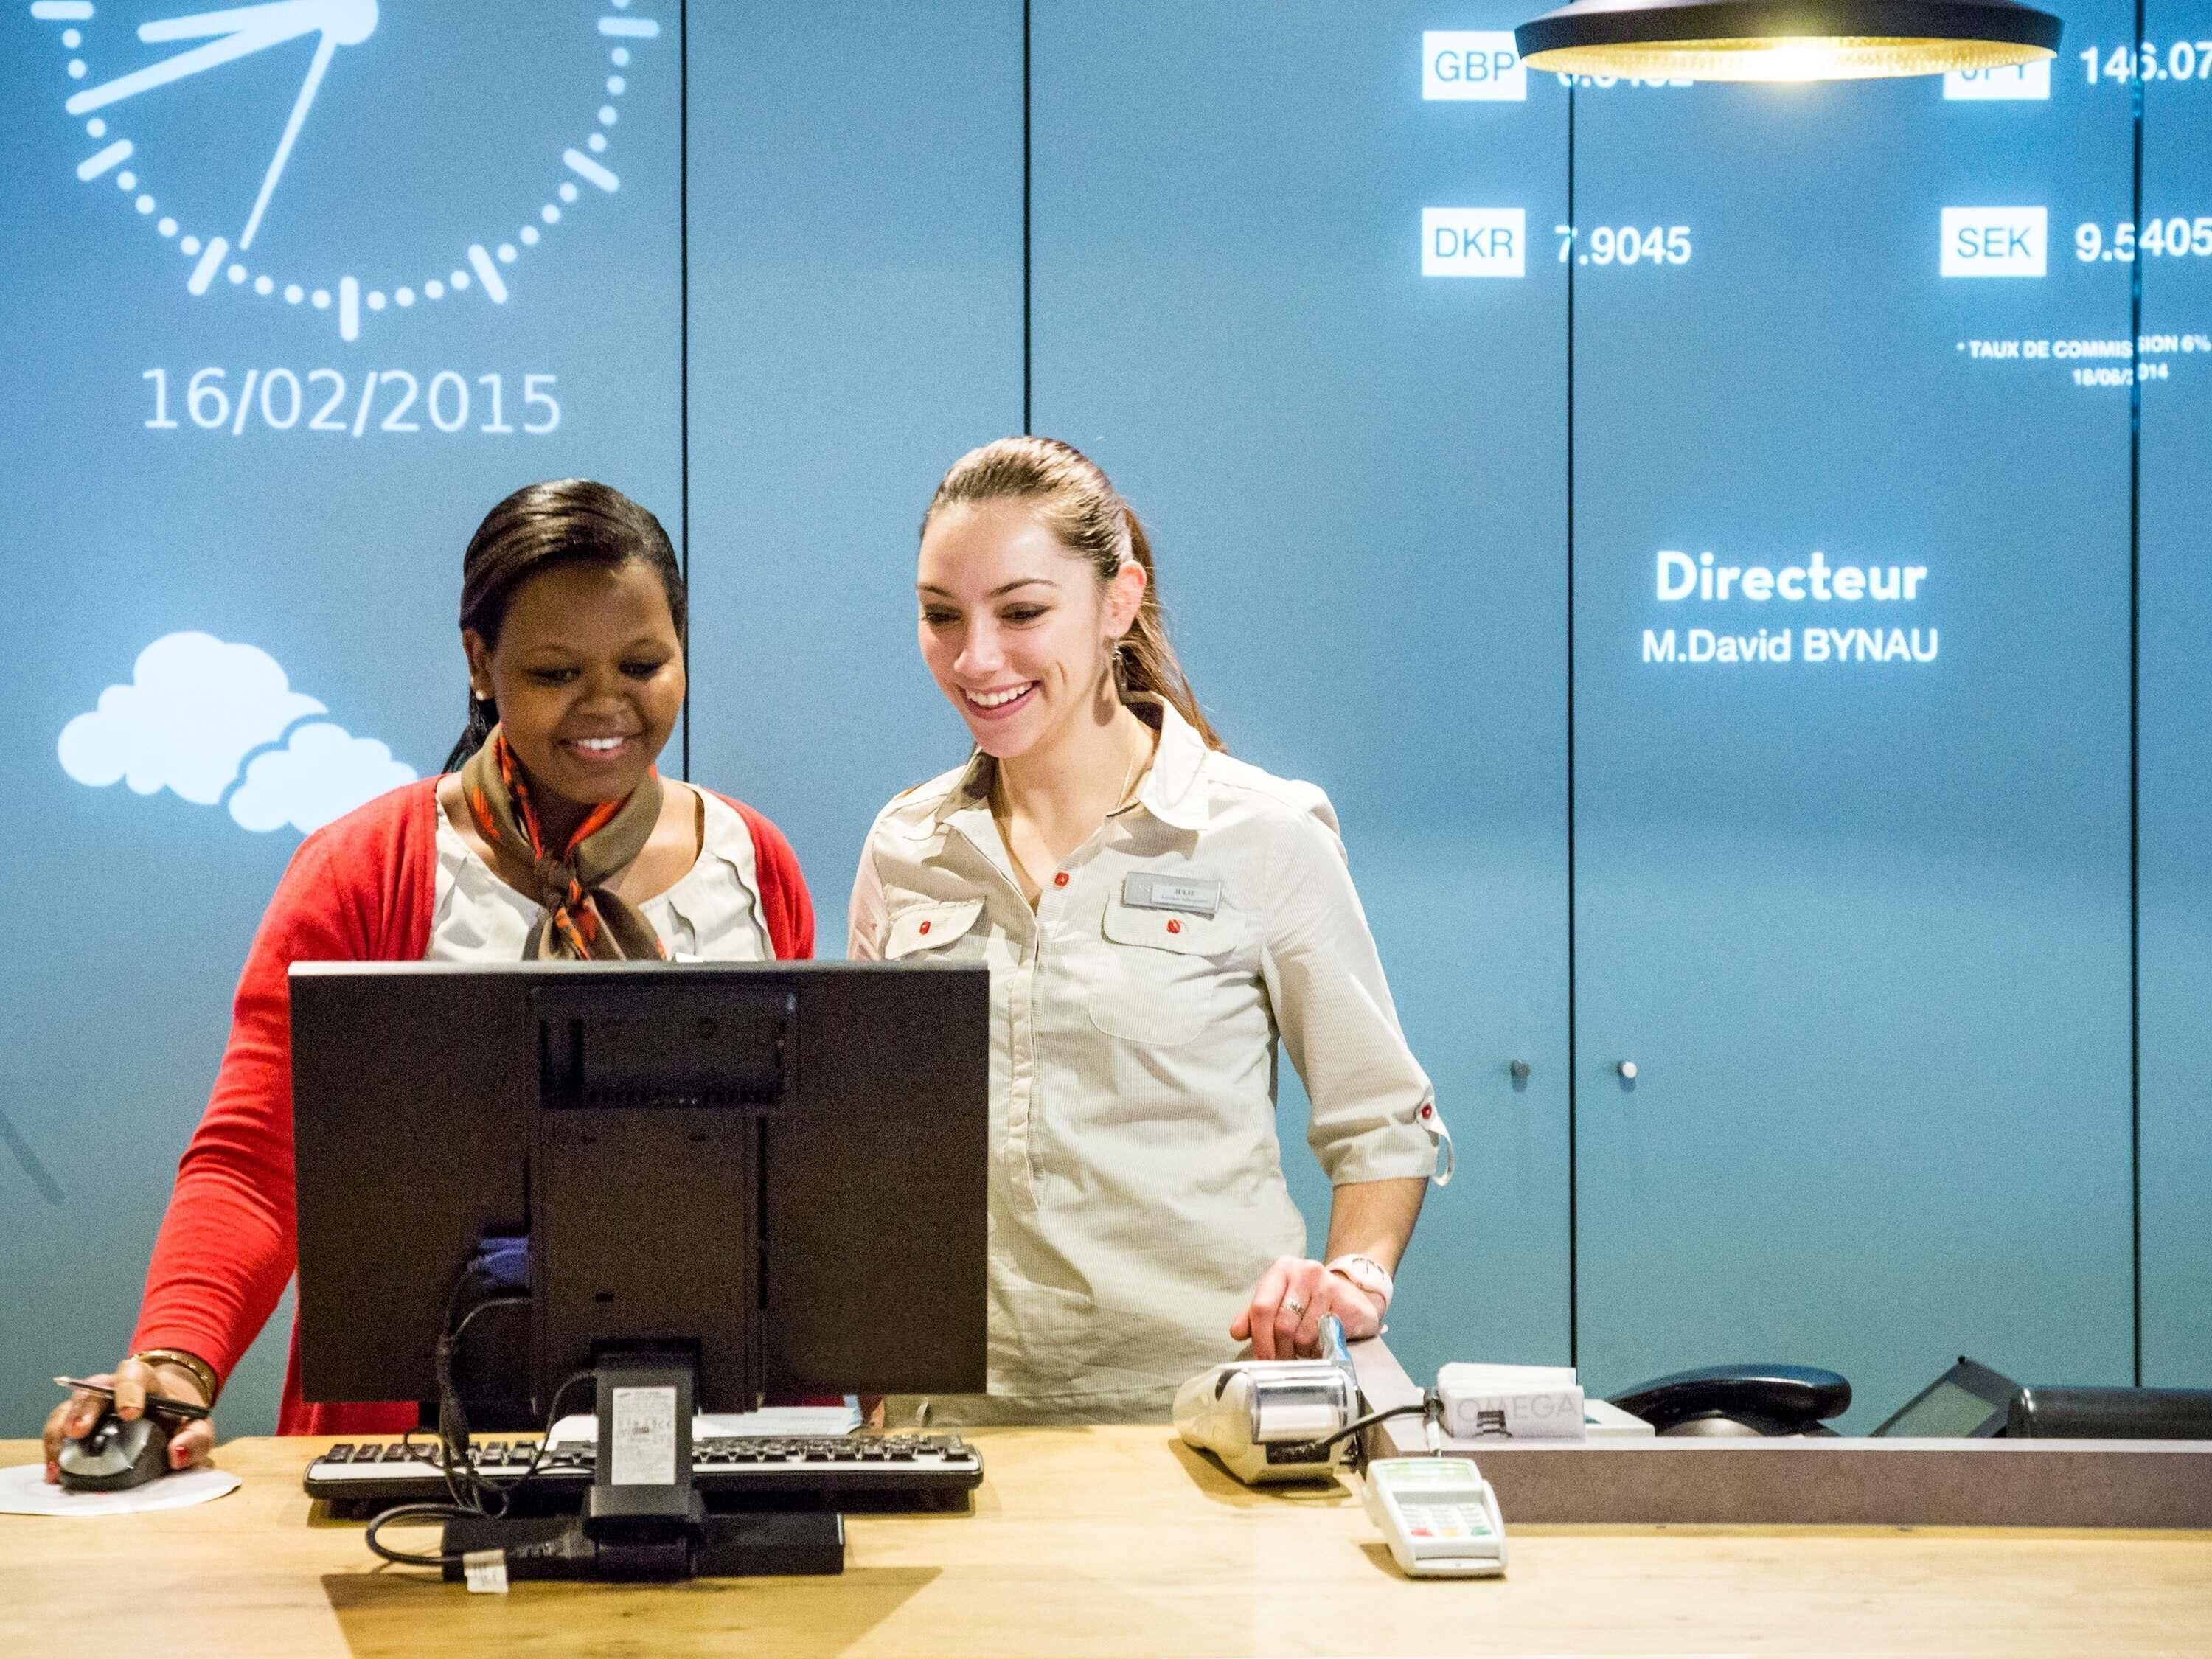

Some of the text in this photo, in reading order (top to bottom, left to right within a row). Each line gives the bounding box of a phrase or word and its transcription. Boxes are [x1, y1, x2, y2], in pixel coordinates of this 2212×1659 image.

[1435, 50, 1515, 82] GBP
[2080, 41, 2212, 85] 146.07
[1436, 225, 1692, 265] DKR 7.9045
[1958, 218, 2212, 262] SEK 9.5405
[1969, 340, 2019, 358] TAUX
[2023, 340, 2051, 358] DE
[142, 366, 561, 437] 16/02/2015
[1656, 551, 1928, 601] Directeur
[1642, 627, 1938, 663] M.David BYNAU
